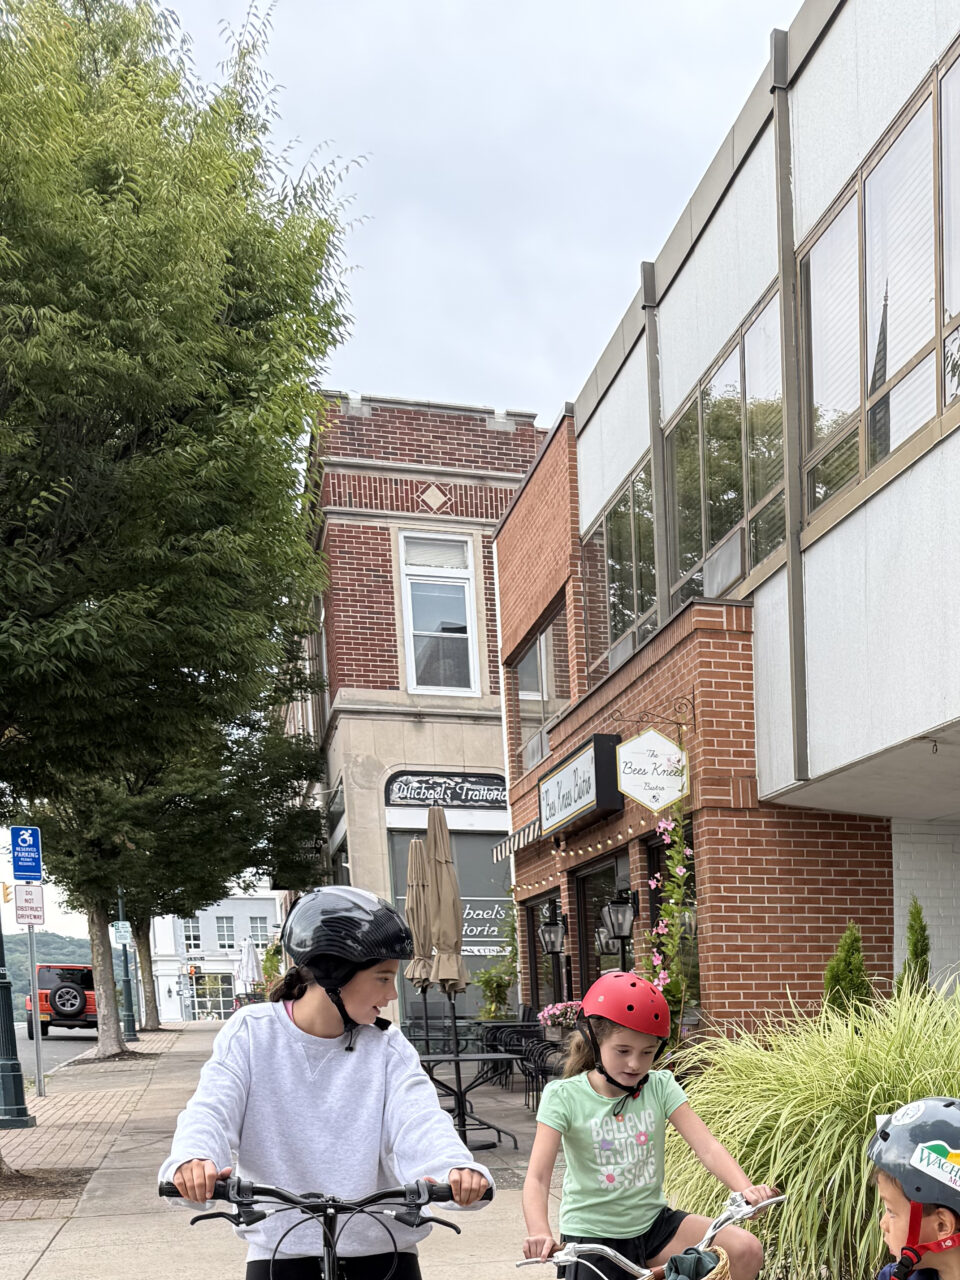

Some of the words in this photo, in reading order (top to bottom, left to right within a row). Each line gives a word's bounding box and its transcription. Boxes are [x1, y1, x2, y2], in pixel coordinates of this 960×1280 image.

[646, 749, 659, 758] The
[622, 760, 648, 775] Bees
[651, 762, 684, 777] Knees
[393, 782, 452, 800] Michael's
[643, 782, 665, 791] Bistro
[545, 788, 556, 821] Bees
[462, 904, 506, 919] hael's
[462, 922, 498, 935] toria
